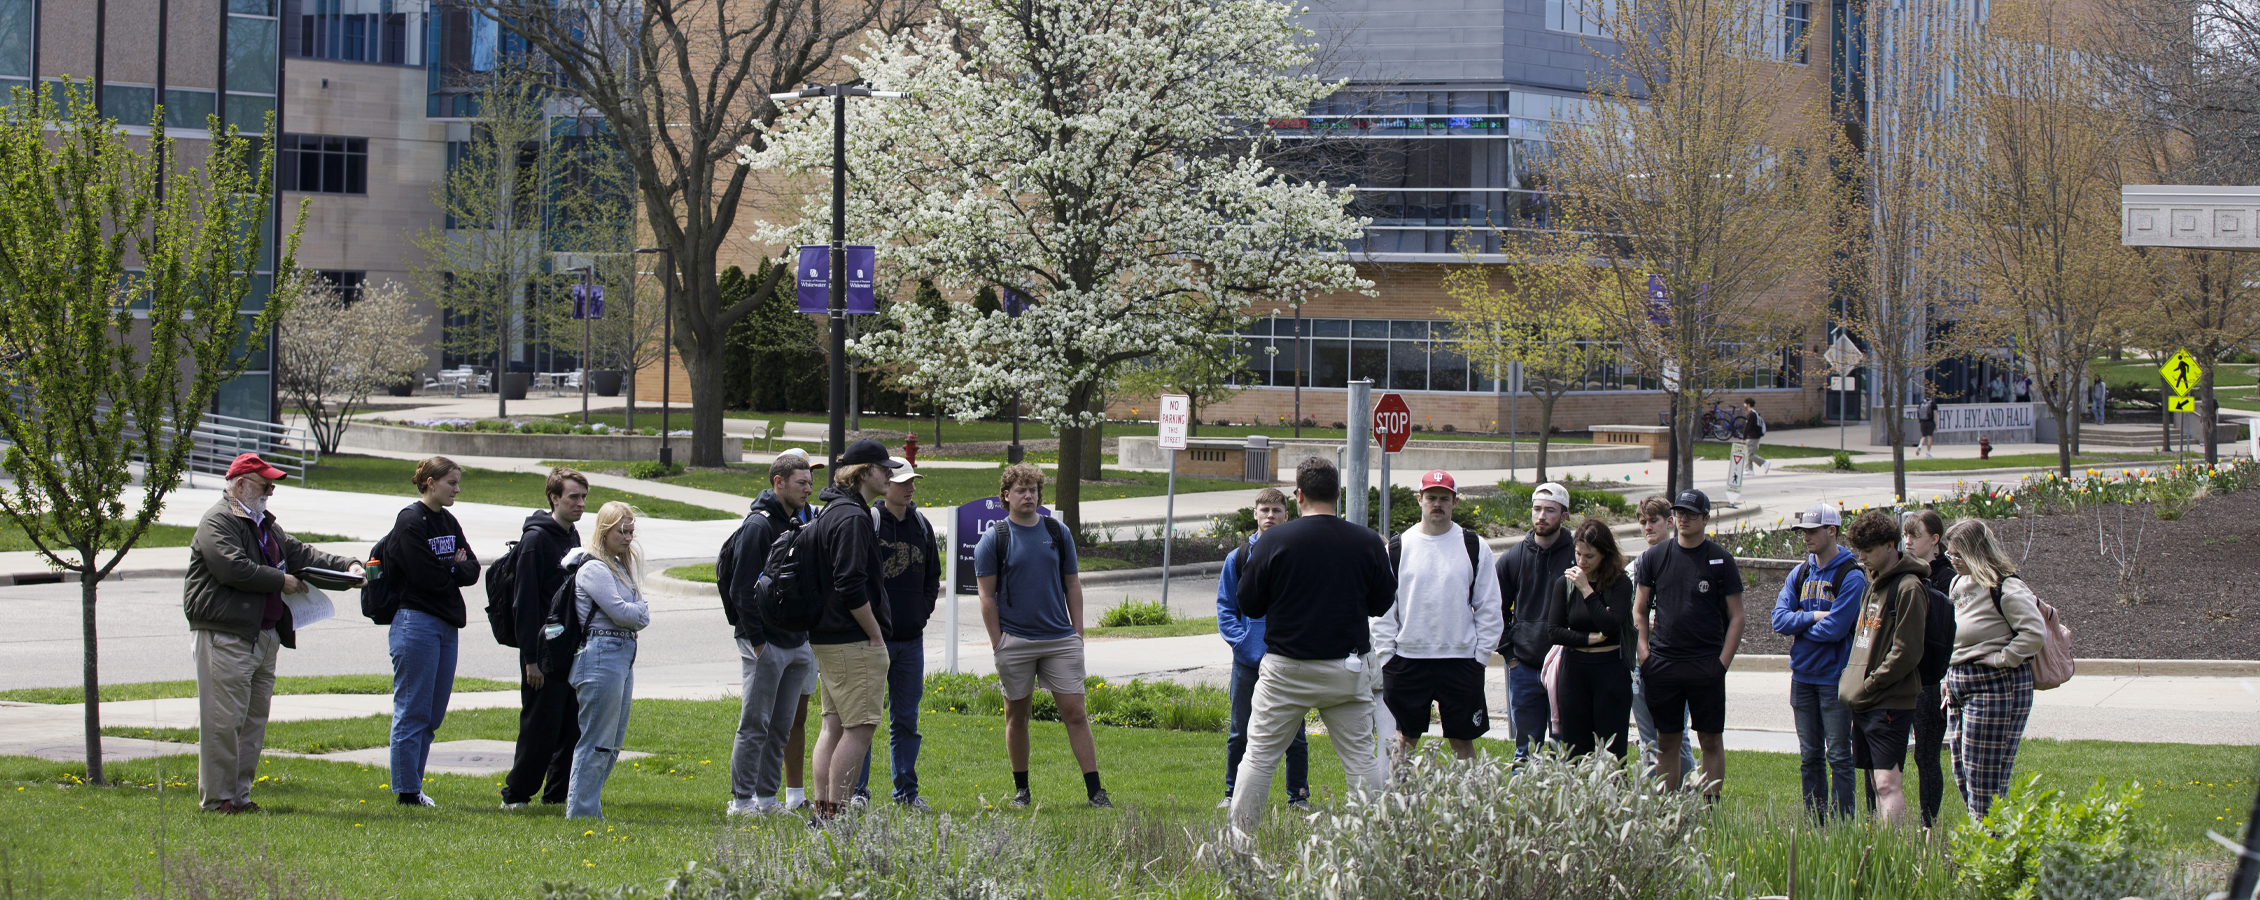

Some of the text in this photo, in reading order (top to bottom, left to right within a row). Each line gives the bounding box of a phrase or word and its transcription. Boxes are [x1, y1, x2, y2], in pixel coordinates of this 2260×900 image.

[1170, 400, 1179, 410] NO
[1162, 414, 1185, 424] PARKING
[1375, 412, 1408, 434] STOP
[1955, 409, 1961, 429] J.
[1964, 408, 2004, 428] HYLAND
[2006, 407, 2030, 426] HALL
[978, 519, 1004, 534] LO
